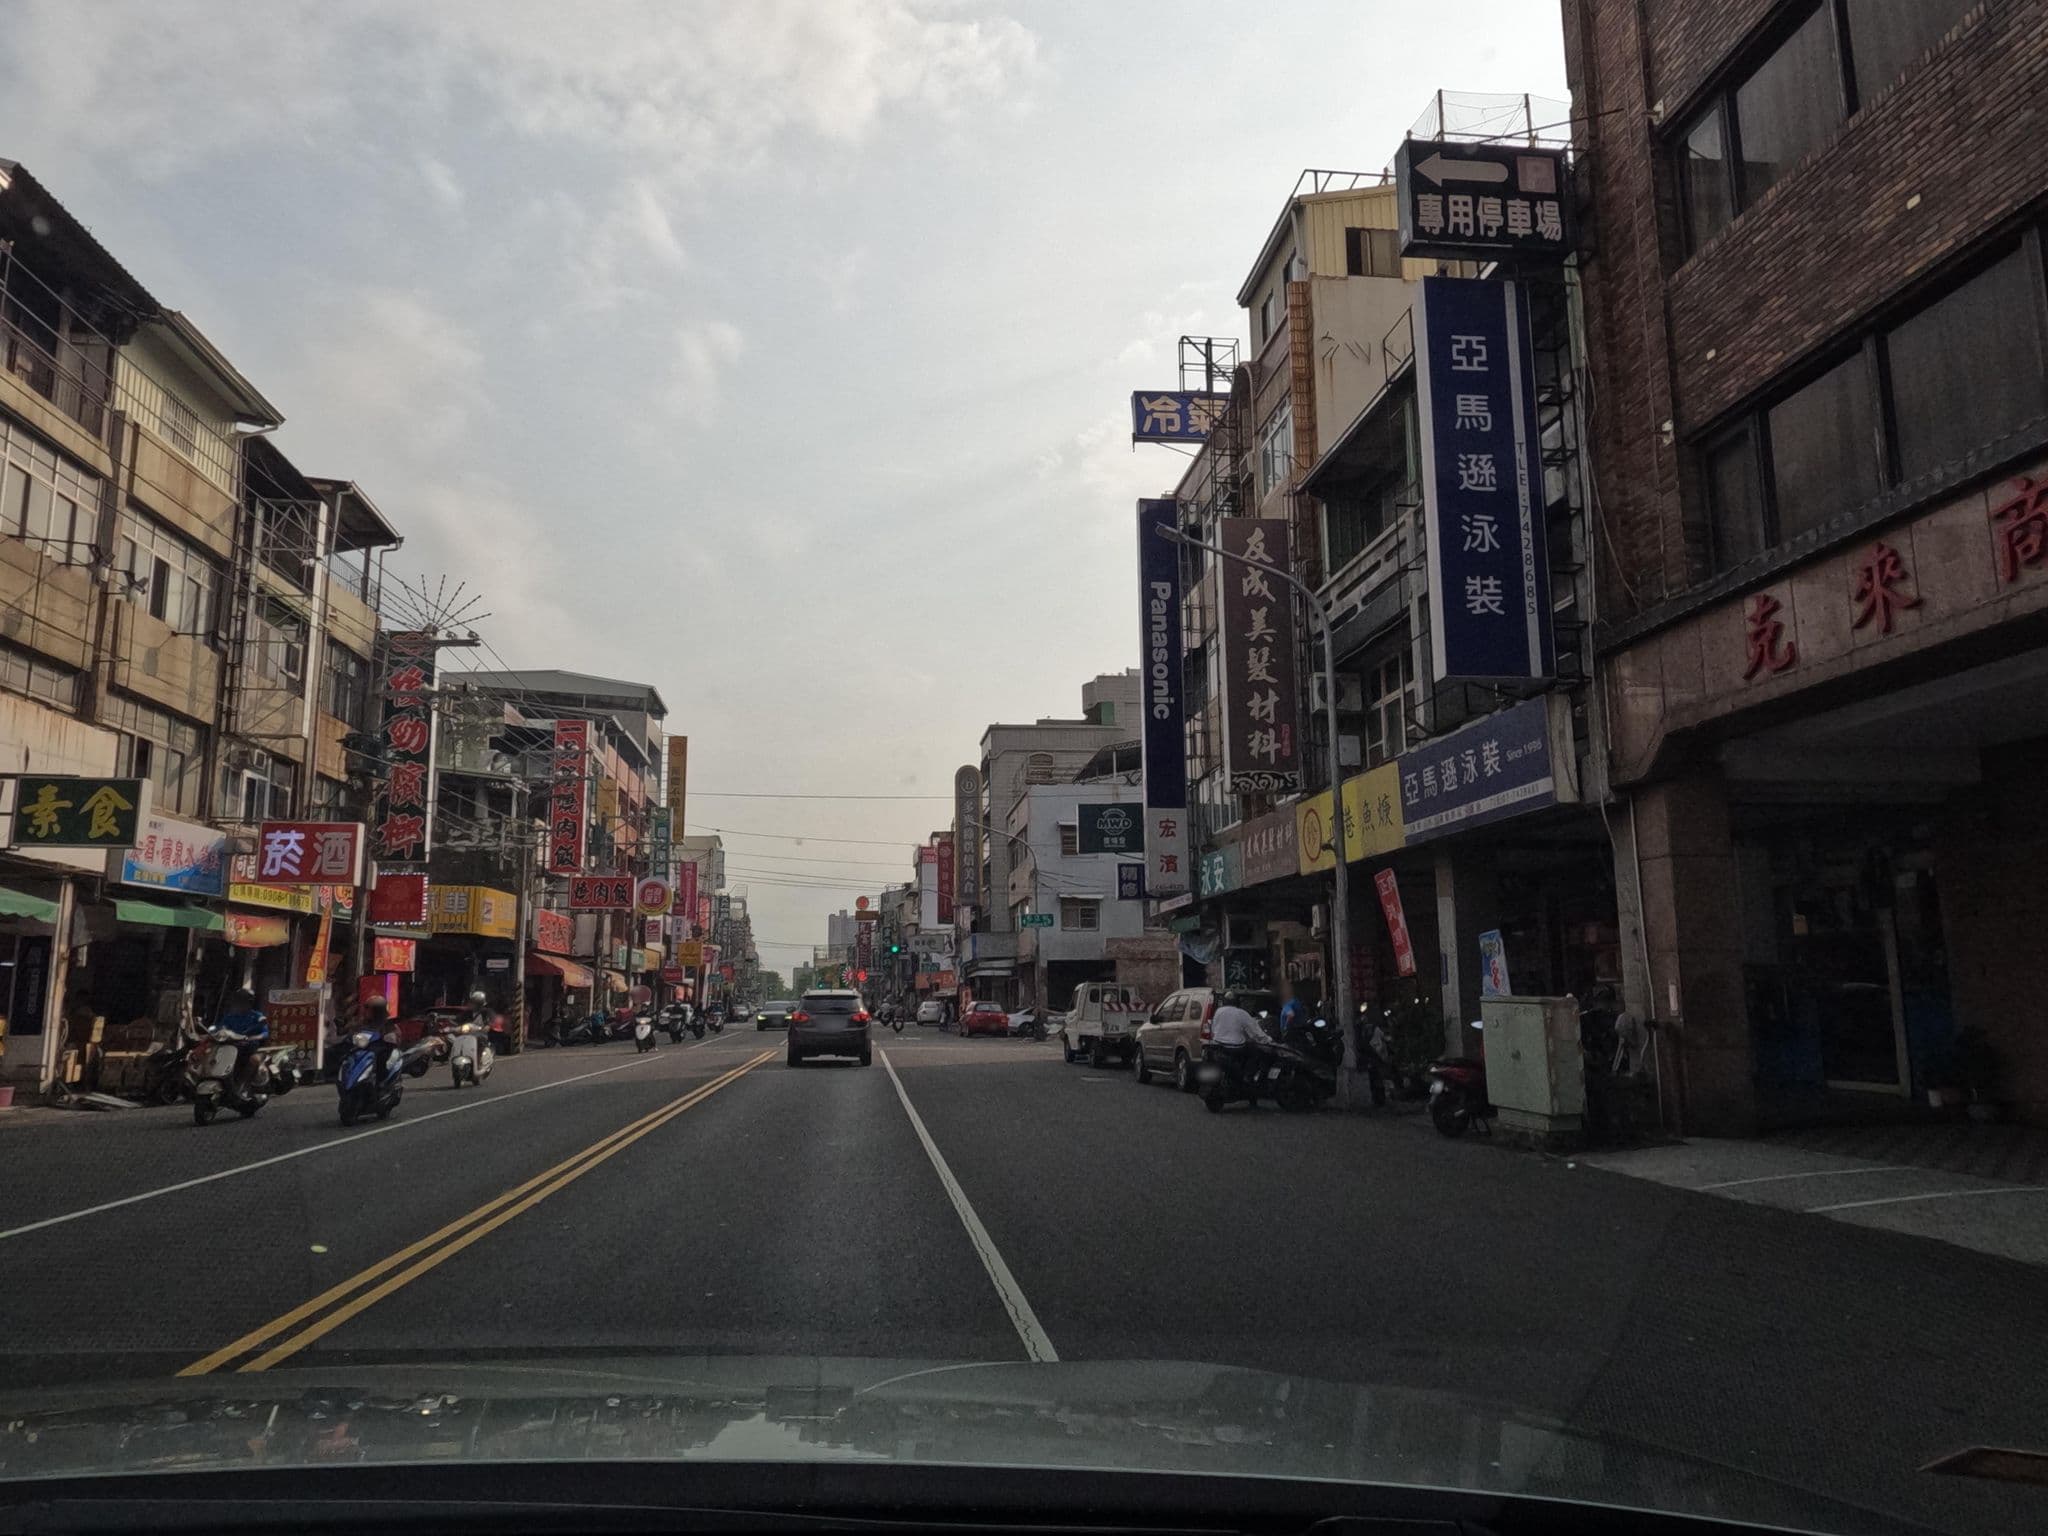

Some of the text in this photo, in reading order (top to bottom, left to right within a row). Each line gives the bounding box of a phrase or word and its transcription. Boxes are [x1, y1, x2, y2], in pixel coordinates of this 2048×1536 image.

[1417, 193, 1562, 242] 專用停車場
[1139, 395, 1227, 434] 冷氣
[1451, 335, 1506, 616] 亞馬遜泳裝
[1151, 581, 1175, 720] Panasonic
[1240, 527, 1282, 765] 友成美髮材料
[1404, 738, 1502, 806] 亞馬遜泳裝
[20, 784, 134, 838] 素食
[1096, 817, 1133, 830] MWD
[262, 830, 353, 877] 菸酒
[1159, 818, 1178, 873] 宏濱
